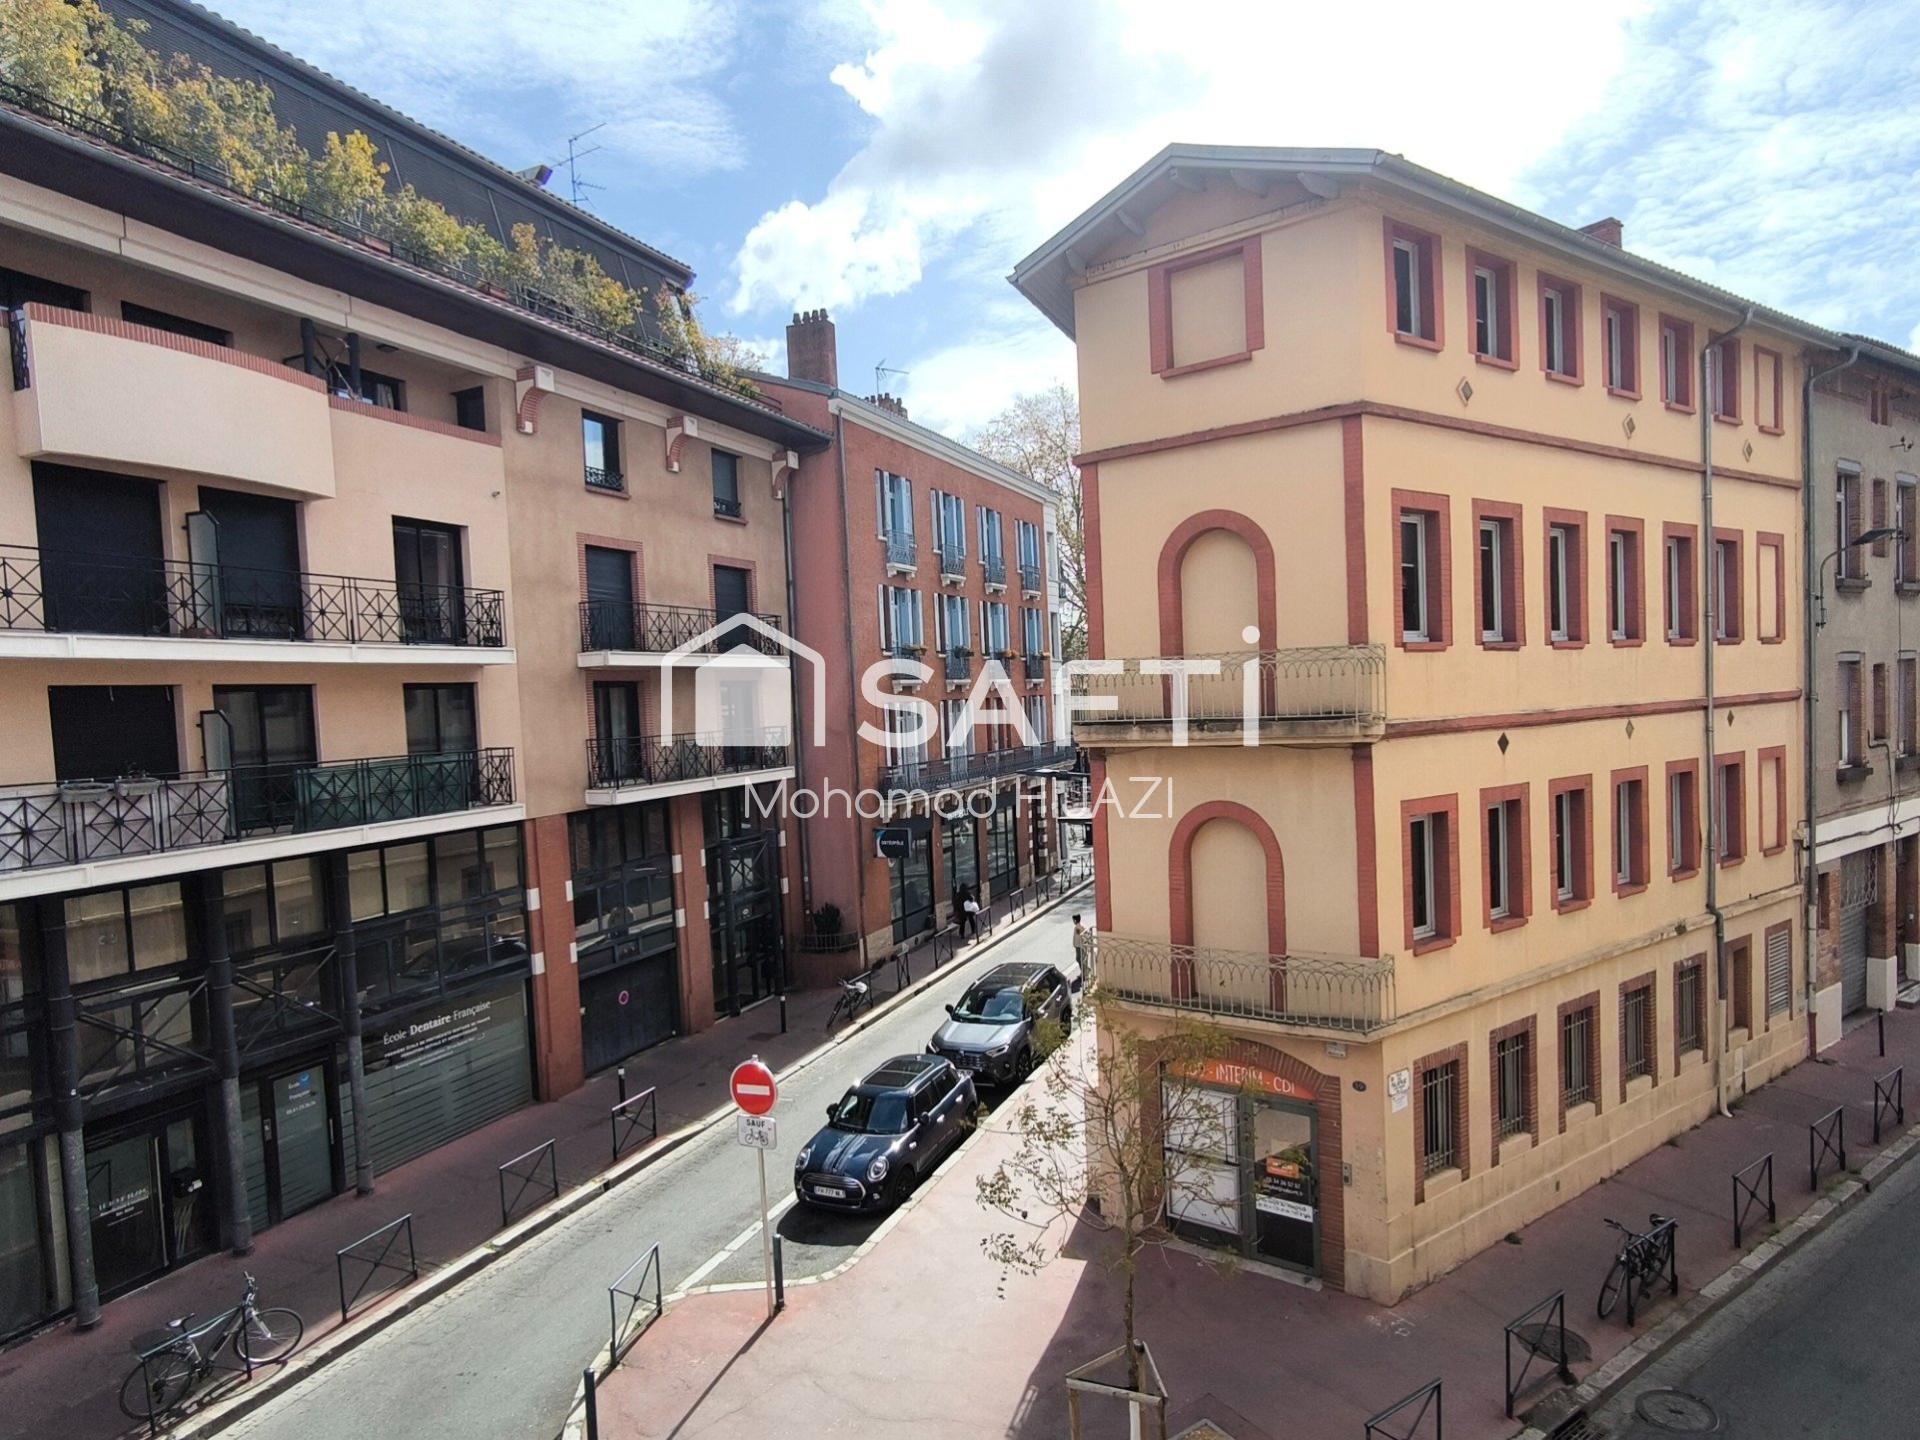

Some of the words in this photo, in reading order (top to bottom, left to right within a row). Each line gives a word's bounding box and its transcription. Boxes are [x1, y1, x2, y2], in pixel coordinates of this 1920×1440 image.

[383, 1029, 408, 1046] École
[409, 1015, 452, 1036] Dentaire
[453, 1001, 491, 1021] Française
[1273, 1076, 1295, 1094] CDI
[746, 1118, 765, 1128] SAUF
